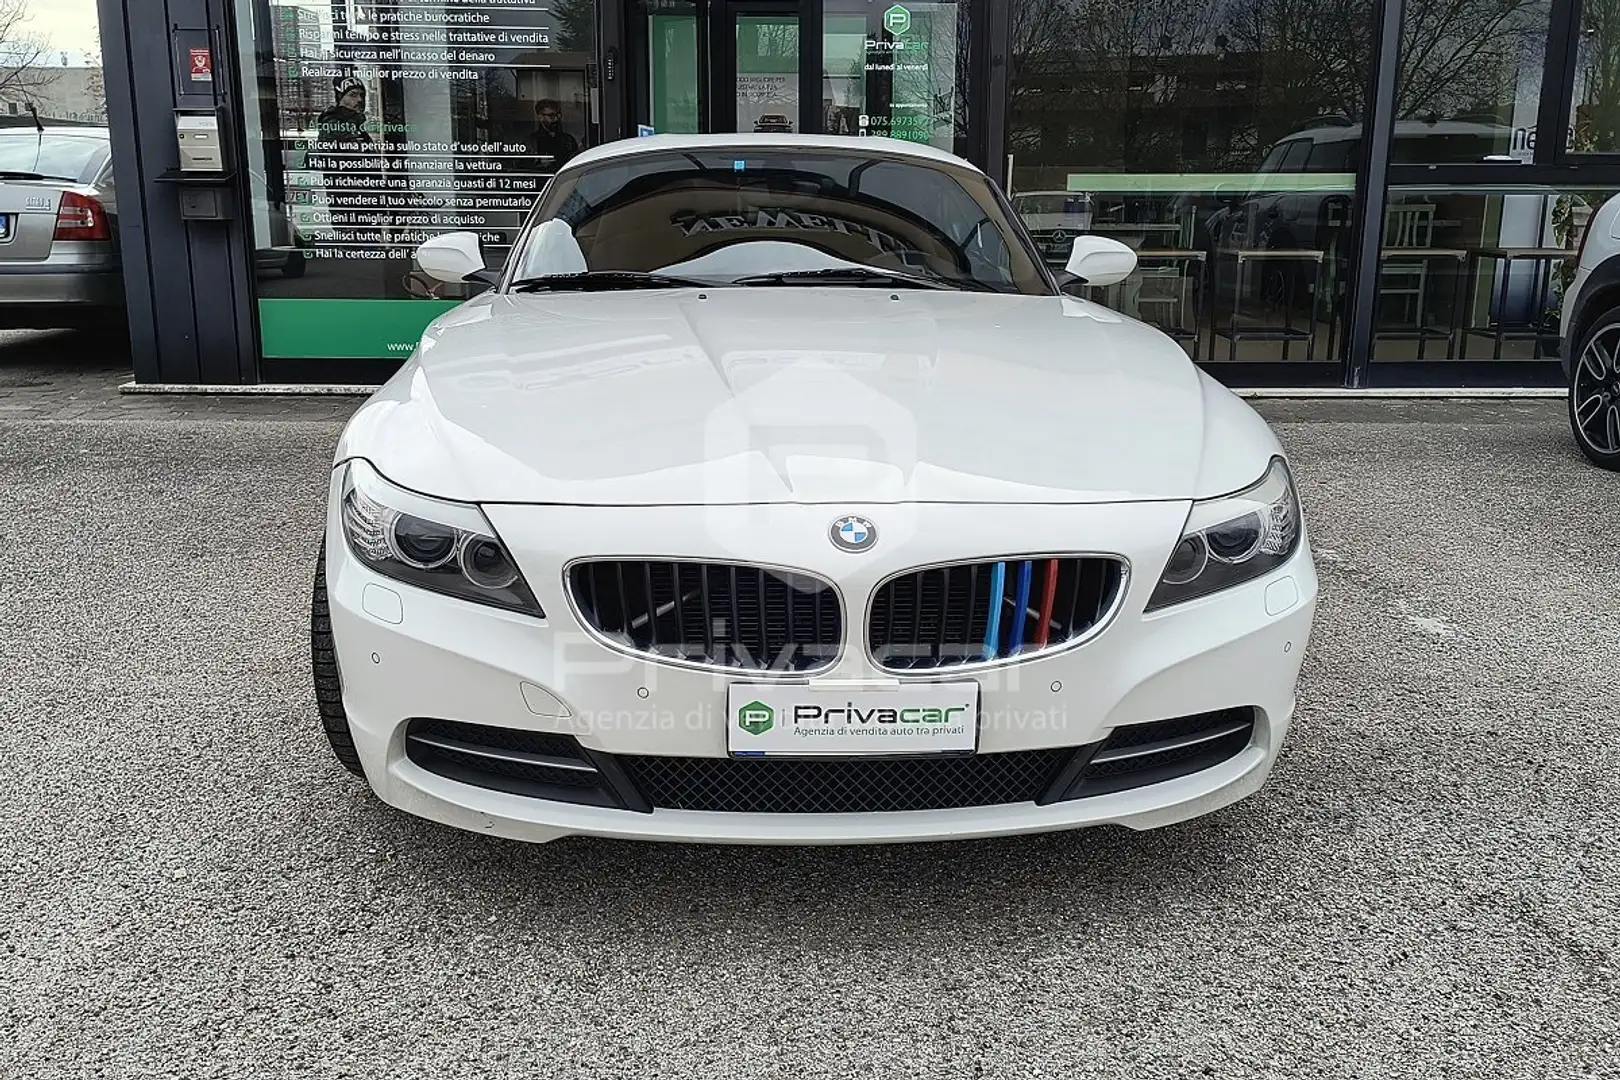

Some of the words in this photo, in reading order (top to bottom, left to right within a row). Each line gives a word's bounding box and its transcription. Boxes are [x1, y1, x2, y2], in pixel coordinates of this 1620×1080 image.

[380, 10, 423, 23] pratiche
[424, 11, 491, 23] burocratiche
[381, 32, 389, 41] e
[390, 31, 420, 41] stress
[421, 30, 447, 41] nelle
[449, 32, 496, 42] trattative
[498, 32, 508, 42] di
[510, 32, 549, 43] vendita
[331, 48, 378, 60] sicurezza
[440, 50, 456, 61] del
[458, 50, 496, 61] denaro
[301, 66, 343, 77] Realizza
[344, 66, 351, 77] il
[352, 66, 390, 80] miglior
[391, 69, 426, 80] prezzo
[428, 69, 439, 80] di
[440, 69, 479, 80] vendita
[308, 120, 357, 134] Acquista
[308, 141, 338, 150] Ricevi
[340, 142, 359, 151] una
[361, 141, 395, 152] perizia
[397, 141, 421, 151] sullo
[422, 141, 448, 152] stato
[450, 141, 479, 152] d'uso
[480, 142, 527, 153] dell'auto
[308, 158, 325, 168] Hai
[328, 158, 338, 168] la
[339, 158, 388, 170] possibilità
[392, 158, 402, 169] di
[404, 159, 454, 170] finanziare
[455, 160, 464, 170] la
[465, 160, 502, 170] vettura
[310, 176, 334, 187] Puoi
[335, 176, 386, 187] richiedere
[387, 178, 407, 188] una
[408, 178, 452, 190] garanzia
[453, 178, 485, 190] guasti
[486, 178, 496, 189] di
[499, 178, 511, 189] 12
[512, 178, 537, 189] mesi
[311, 195, 335, 205] Puoi
[336, 195, 378, 206] vendere
[379, 195, 386, 205] il
[387, 196, 406, 206] tuo
[407, 196, 446, 207] veicolo
[446, 197, 474, 207] senza
[475, 196, 532, 209] permutarlo
[313, 212, 348, 223] Ottieni
[349, 213, 356, 223] il
[357, 213, 394, 225] miglior
[395, 215, 429, 226] prezzo
[431, 214, 441, 224] di
[442, 214, 486, 226] acquisto
[314, 231, 355, 241] Snellisci
[356, 231, 381, 241] tutte
[383, 231, 393, 241] le
[315, 248, 332, 259] Hai
[334, 248, 345, 259] la
[345, 249, 386, 259] certezza
[793, 702, 966, 724] Privacar
[793, 726, 836, 737] Agenzia
[837, 726, 848, 736] di
[849, 726, 889, 736] vendita
[889, 727, 914, 736] auto
[916, 727, 930, 736] tra
[932, 725, 965, 737] privati
